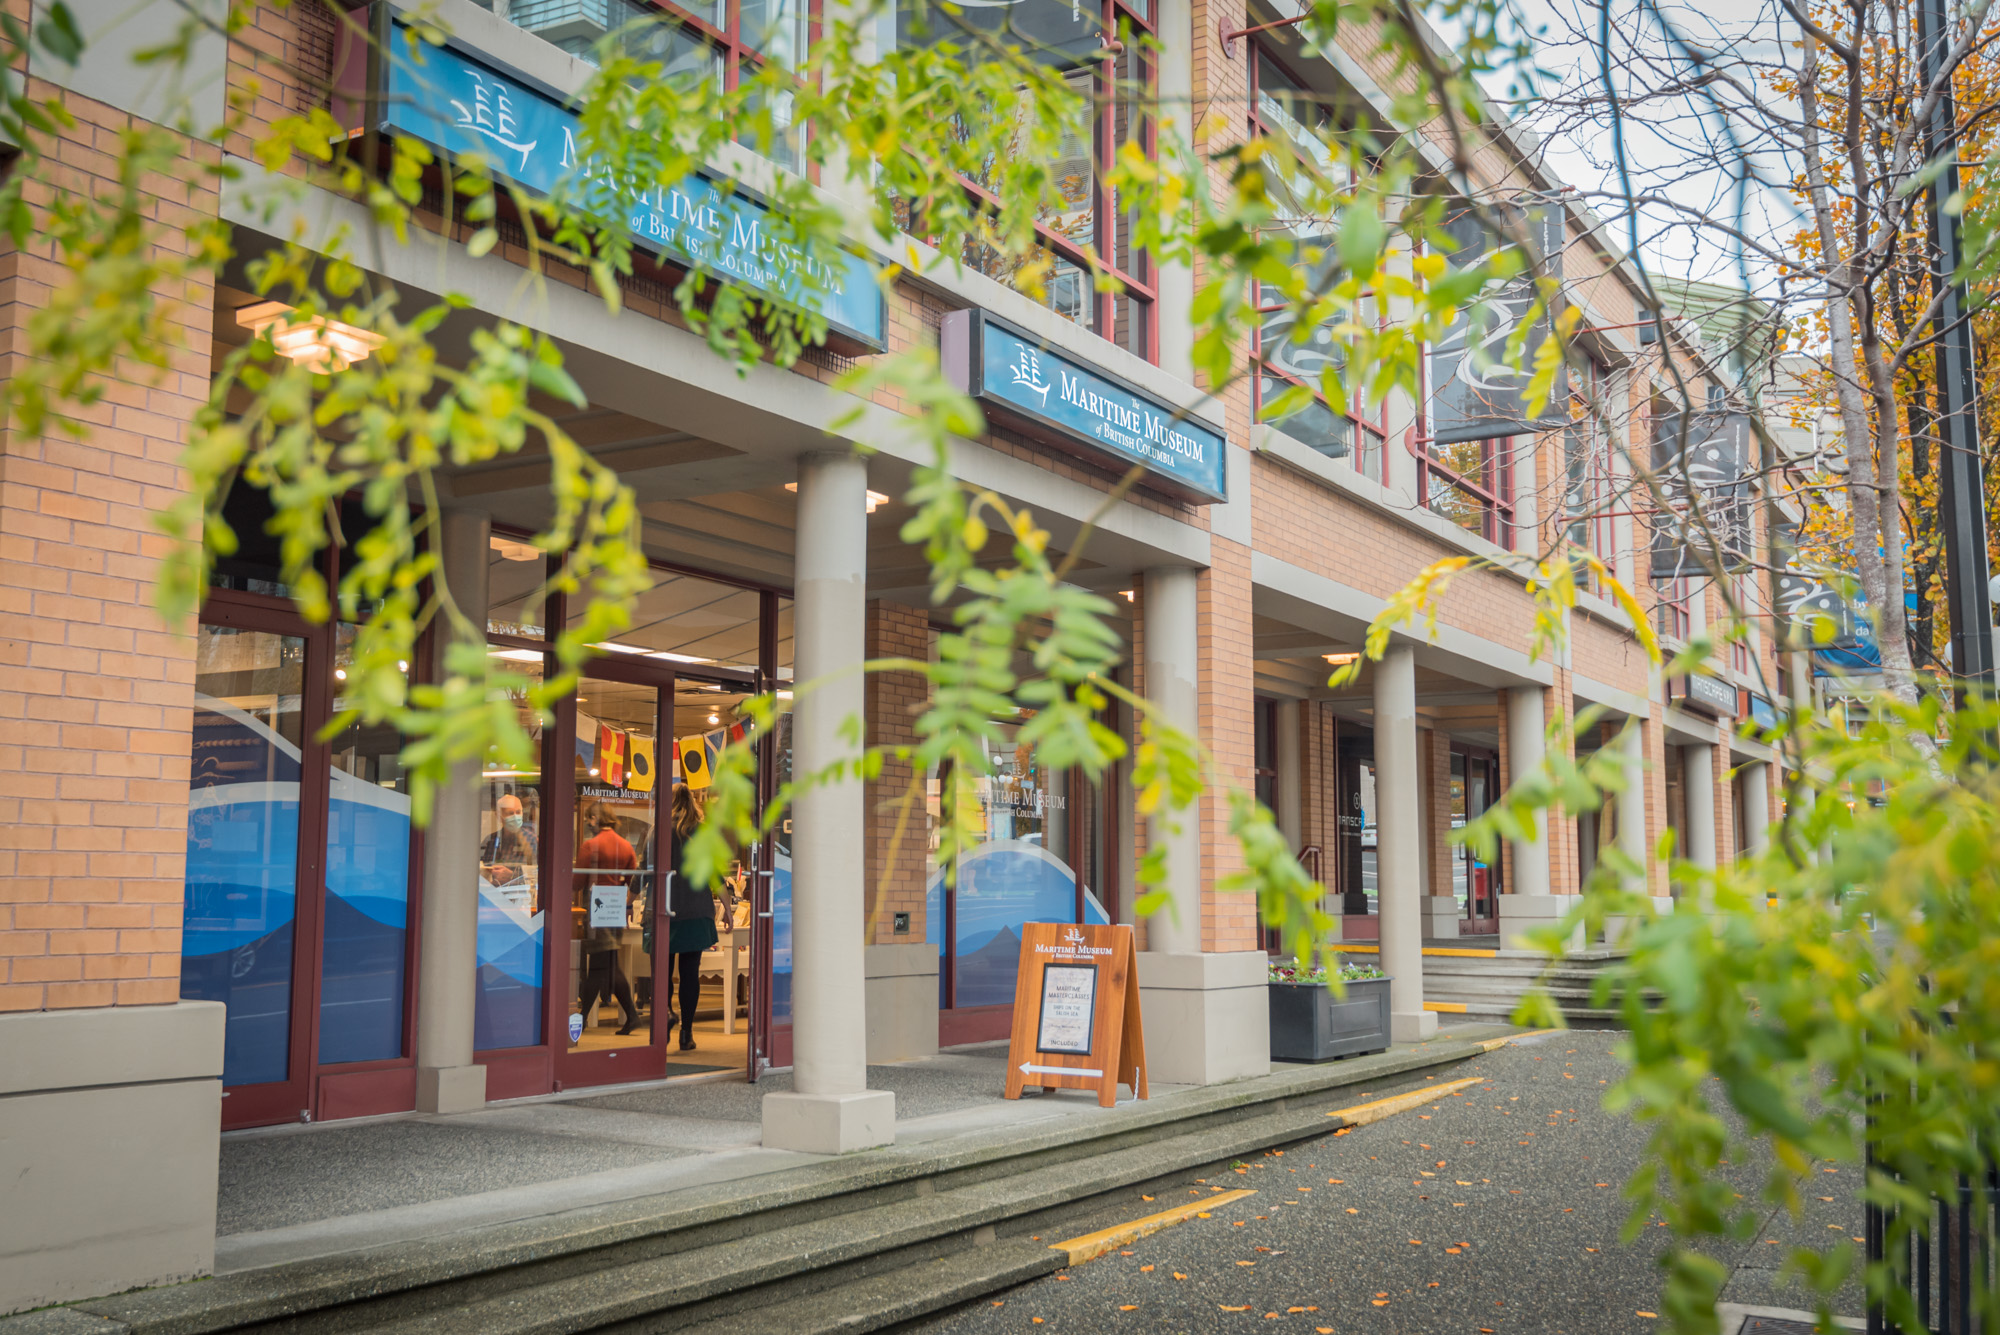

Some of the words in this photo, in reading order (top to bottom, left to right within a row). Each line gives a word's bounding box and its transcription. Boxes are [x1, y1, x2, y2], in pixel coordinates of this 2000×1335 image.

[631, 214, 644, 233] of
[649, 213, 709, 260] BRIISH
[1131, 397, 1140, 410] The
[1060, 370, 1141, 434] MARITIME
[1144, 411, 1204, 463] MUSEUM
[1095, 425, 1103, 438] of
[1103, 424, 1135, 450] BRITISH
[1135, 437, 1175, 468] COLUMBIA
[582, 785, 619, 797] MARITIME
[620, 789, 649, 799] MUSEUM
[971, 786, 1020, 804] RITIME
[1035, 944, 1076, 953] MARITIME
[1077, 945, 1112, 955] MUSEUM
[1048, 992, 1090, 1000] MASTERCLASSES
[1050, 1039, 1079, 1047] INCLUDED
